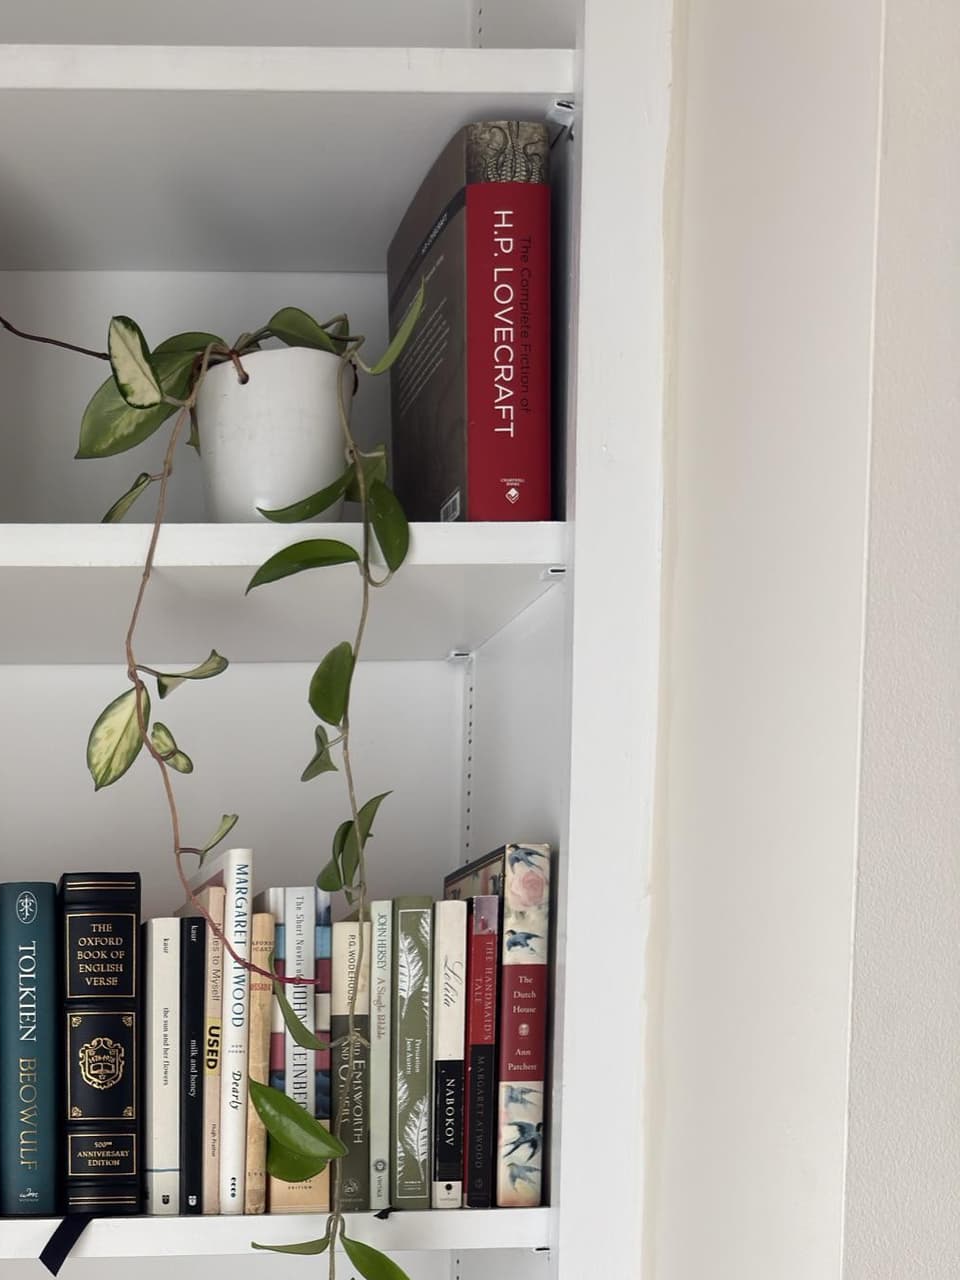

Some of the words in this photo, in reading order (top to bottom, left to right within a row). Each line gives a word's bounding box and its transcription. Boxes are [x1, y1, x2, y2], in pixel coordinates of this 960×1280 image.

[493, 210, 513, 256] H.P.
[493, 267, 514, 437] LOVECRAFT
[79, 938, 122, 946] OXFORD
[90, 925, 112, 933] THE
[77, 951, 107, 960] BOOK
[109, 951, 124, 959] OF
[79, 964, 123, 973] ENGLISH
[18, 941, 36, 1042] TOLKIEN
[83, 977, 118, 986] VERSE
[442, 959, 464, 1008] Lolita
[190, 1040, 198, 1057] milk
[206, 1025, 219, 1070] USED
[189, 1075, 197, 1097] honey
[229, 1070, 242, 1110] Dearly
[20, 1058, 37, 1170] BEOWULF
[445, 1079, 456, 1146] NABOKOV
